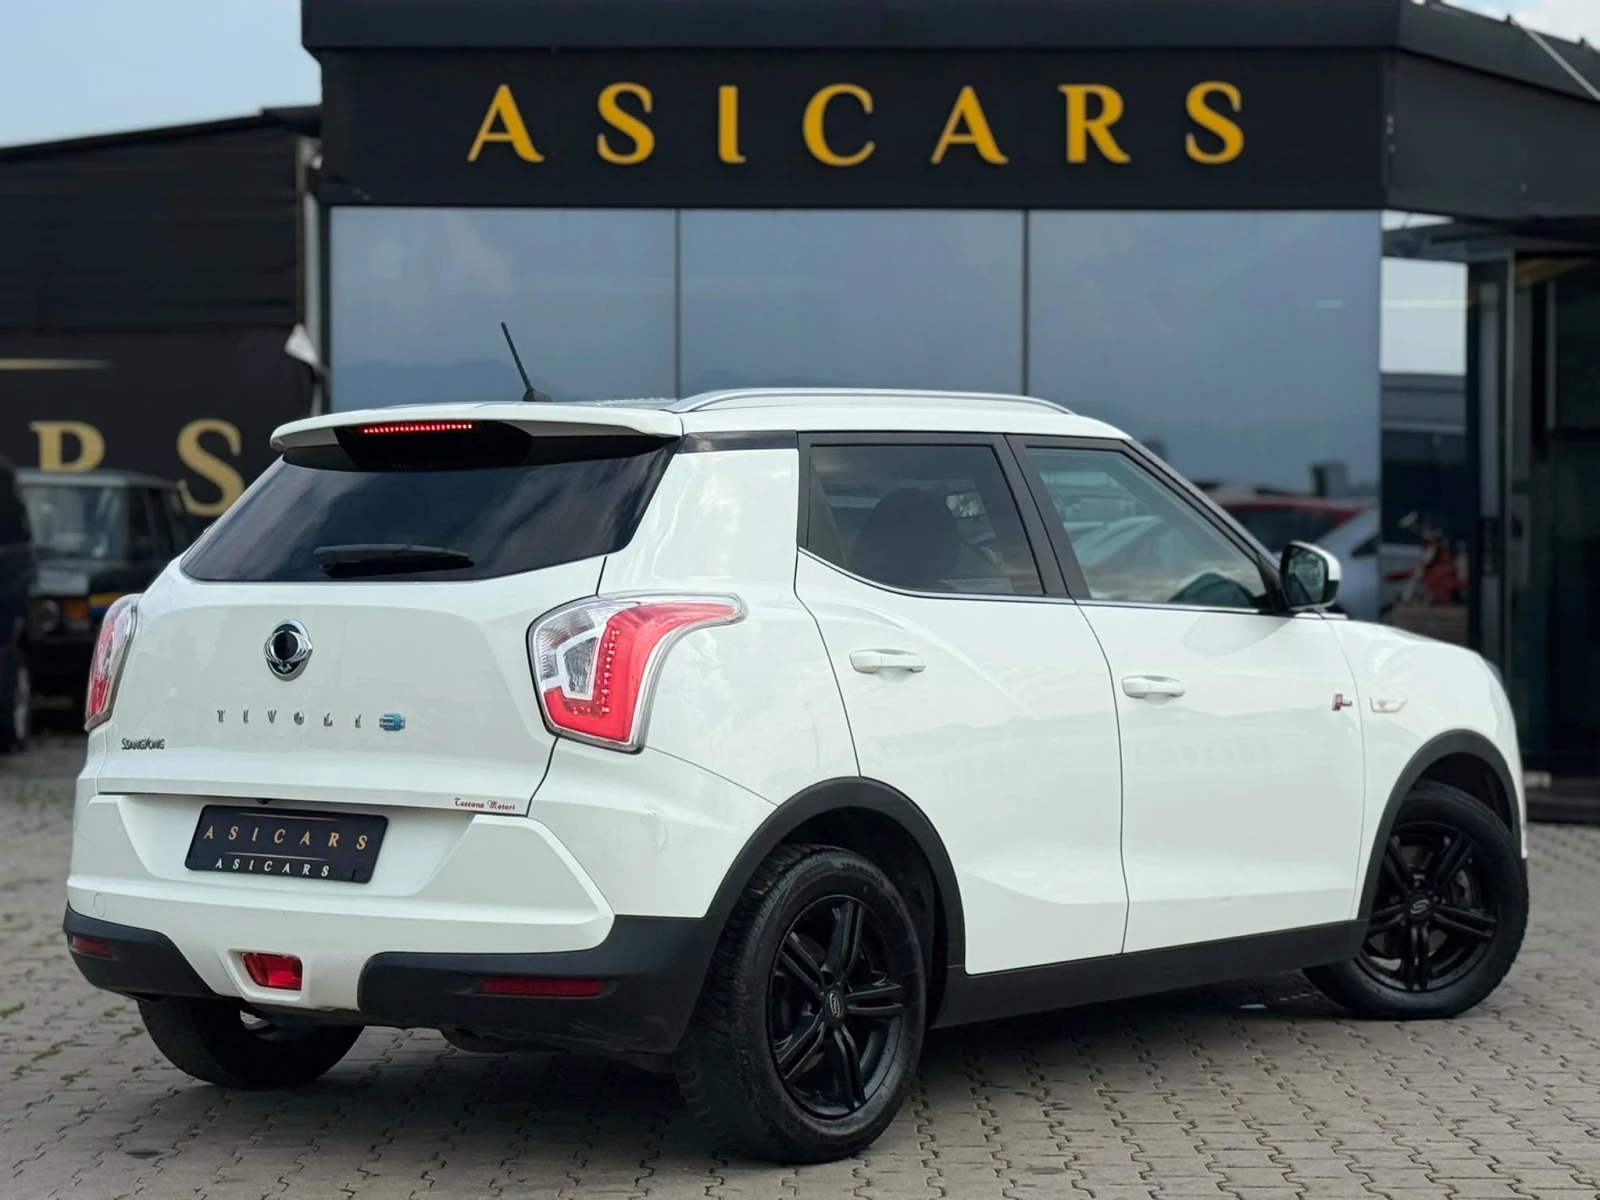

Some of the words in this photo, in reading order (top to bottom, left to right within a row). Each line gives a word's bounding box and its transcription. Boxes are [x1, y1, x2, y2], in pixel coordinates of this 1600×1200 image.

[467, 81, 1245, 166] ASICARS
[216, 709, 362, 729] TIVOLI
[487, 799, 516, 811] Motori
[203, 825, 368, 850] ASICARS
[214, 858, 330, 877] ASICARS
